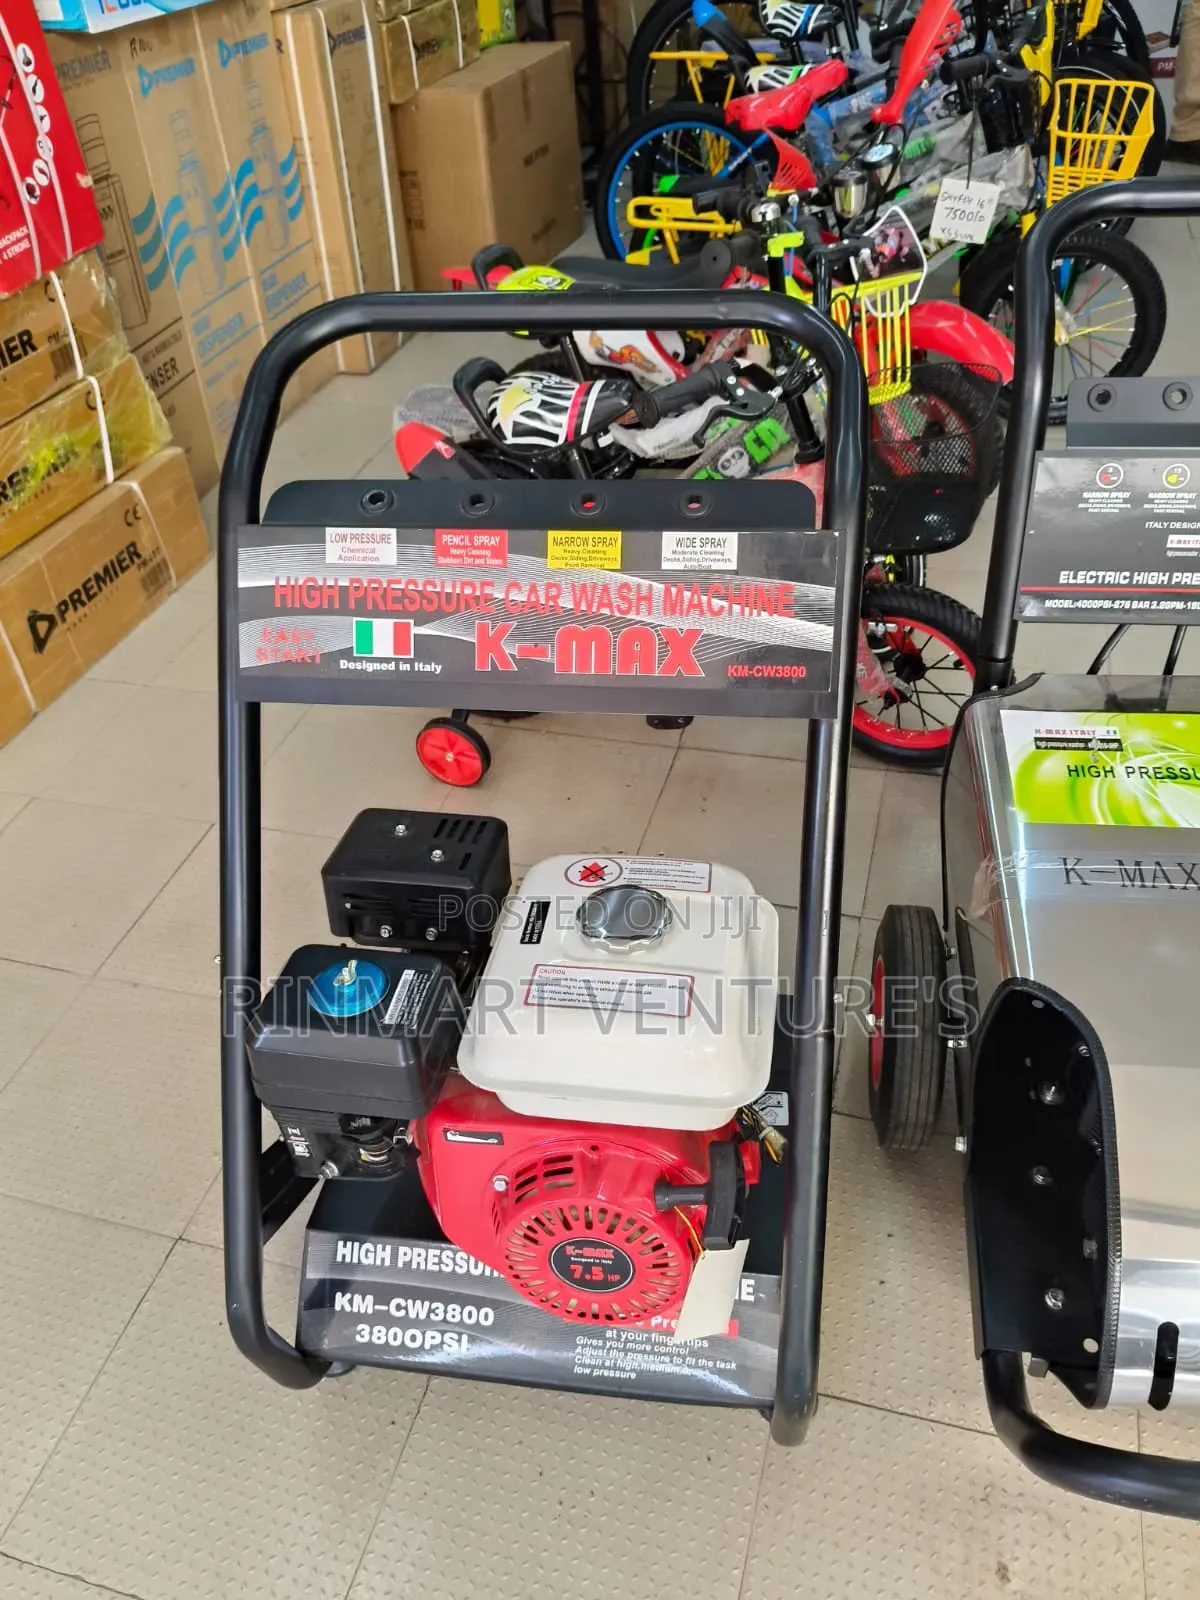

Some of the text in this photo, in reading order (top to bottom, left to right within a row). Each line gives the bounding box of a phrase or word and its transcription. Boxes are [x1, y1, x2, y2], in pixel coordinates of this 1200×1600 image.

[330, 533, 392, 544] LOW PRESSURE
[442, 534, 500, 546] PENCIL SPRAY
[552, 536, 618, 549] NARROW SPRAY
[675, 537, 727, 549] WIDE SPRAY
[341, 546, 376, 555] Chemical
[582, 549, 607, 557] Cleaning
[337, 554, 380, 563] Application
[56, 541, 142, 624] PREMIER
[1059, 570, 1130, 584] ELECTRIC
[1133, 571, 1169, 585] HIGH
[273, 576, 795, 618] HIGH PRESSURE CAR WASH MACHINE
[262, 627, 317, 645] EASY
[256, 647, 321, 664] START
[475, 620, 705, 677] K-MAX
[340, 660, 443, 675] Designed in Italy
[727, 664, 807, 678] KM-CW3800
[1067, 765, 1116, 778] HIGH
[539, 968, 566, 976] CAUTION
[336, 1240, 392, 1267] HIGH
[565, 1245, 615, 1259] K-MAX
[569, 1264, 621, 1282] 7.5 HP
[334, 1292, 495, 1326] KM-CW3800
[576, 1336, 690, 1355] Gives you more control
[605, 1329, 709, 1349] at your fingrtips
[574, 1356, 602, 1367] Clean
[604, 1358, 615, 1368] at
[575, 1345, 737, 1370] Adjust the pressure to fit the task
[573, 1365, 637, 1380] low pressure
